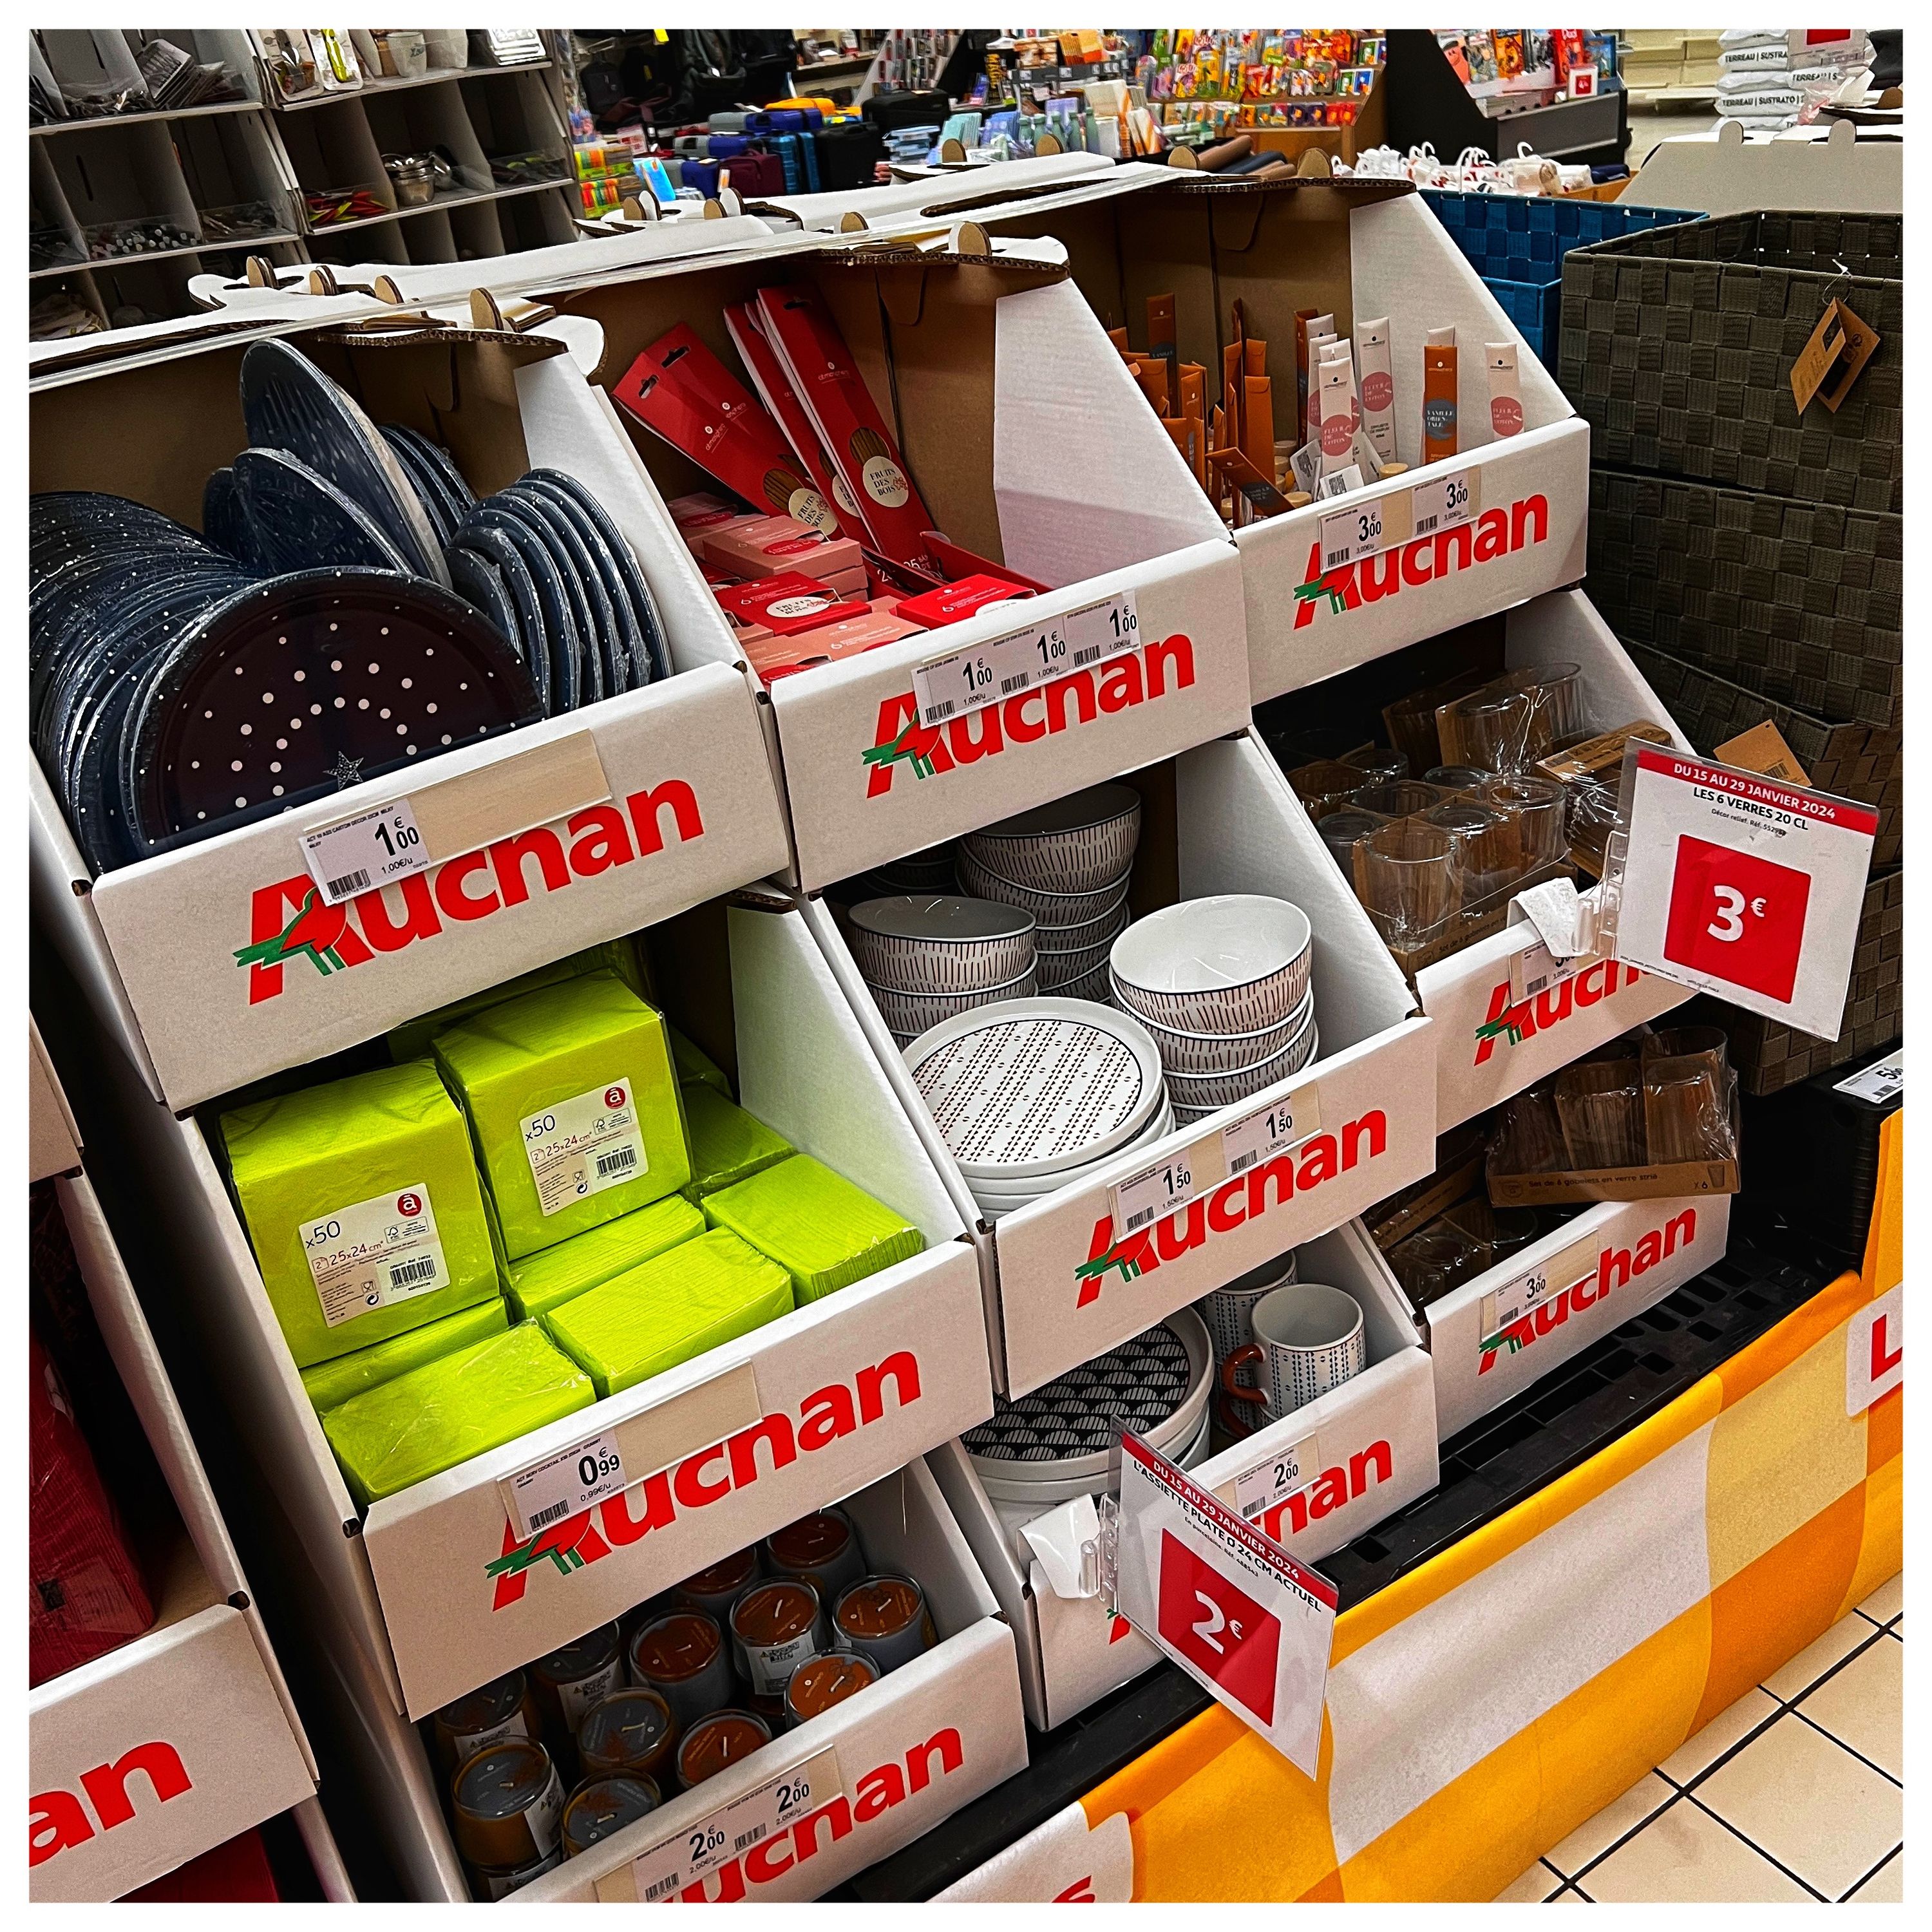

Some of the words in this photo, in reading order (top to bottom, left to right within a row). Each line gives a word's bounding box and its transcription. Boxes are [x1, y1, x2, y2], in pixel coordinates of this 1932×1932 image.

[1725, 53, 1755, 62] TERREAU
[1761, 51, 1788, 60] SUSTRA
[1722, 97, 1753, 106] TERREAU
[869, 468, 896, 480] FRUITS
[873, 478, 890, 488] DES
[877, 486, 896, 497] BOIS
[797, 494, 815, 519] FRUITS
[804, 508, 817, 524] DES
[1674, 762, 1692, 777] DU
[1693, 768, 1708, 782] 15
[1710, 773, 1728, 787] AU
[1730, 780, 1745, 791] 29
[1747, 784, 1800, 809] JANVIER
[1802, 800, 1836, 820] 2024
[1693, 787, 1715, 802] LES
[1716, 793, 1725, 804] 6
[1726, 795, 1774, 819] VERRES
[1776, 810, 1792, 825] 20
[1794, 817, 1809, 831] CL
[381, 857, 414, 875] 1,00€/u
[232, 780, 705, 1006] Auchan
[525, 1114, 556, 1142] x50
[545, 1134, 578, 1157] 25x24
[1564, 1177, 1600, 1187] gobelets
[305, 1220, 341, 1249] x50
[329, 1243, 368, 1266] 25x24
[580, 1482, 612, 1502] 0,99€/u
[1153, 1460, 1169, 1479] DU
[1170, 1473, 1183, 1490] 15
[1184, 1482, 1200, 1504] AU
[1202, 1499, 1216, 1516] 29
[1217, 1511, 1266, 1555] JANVIER
[1267, 1549, 1300, 1580] 2024
[1133, 1459, 1189, 1512] L'ASSIETTE
[1191, 1506, 1226, 1541] PLATE
[1237, 1543, 1253, 1561] 24
[1254, 1555, 1273, 1577] CM
[1274, 1571, 1322, 1613] ACTUEL
[775, 1807, 802, 1825] 2,00€/u
